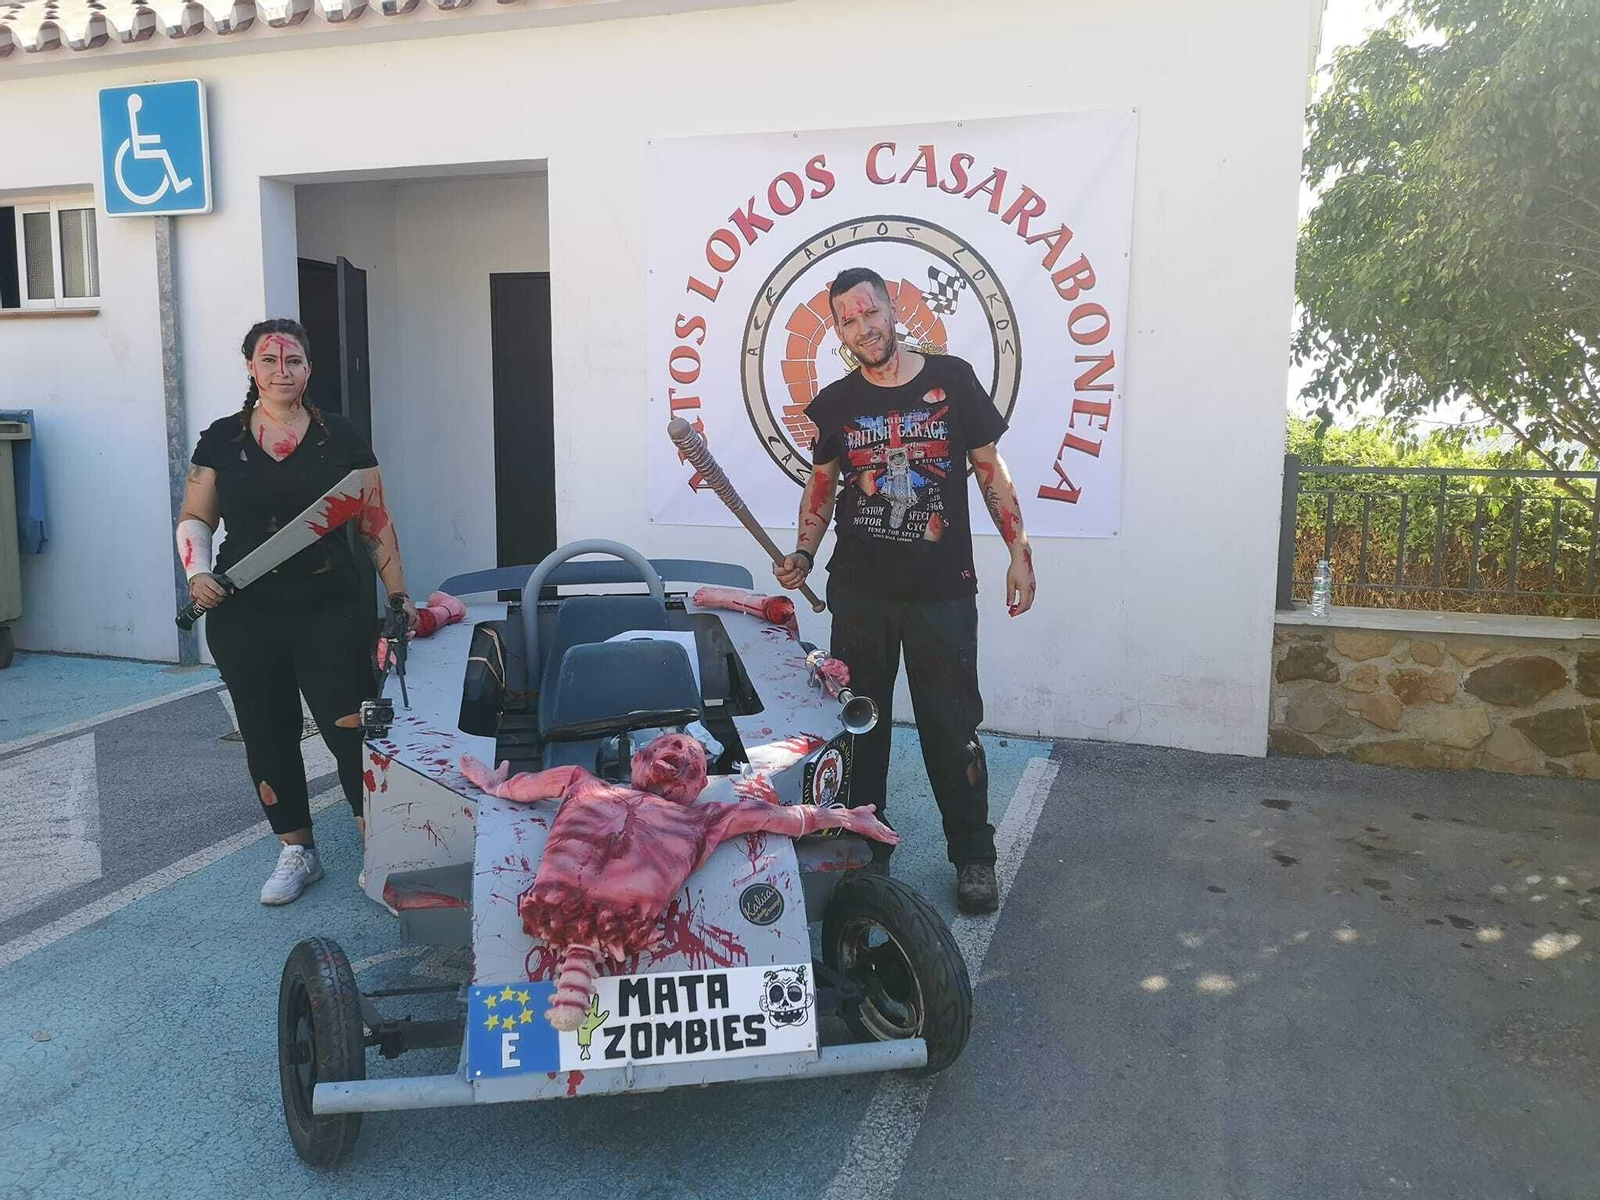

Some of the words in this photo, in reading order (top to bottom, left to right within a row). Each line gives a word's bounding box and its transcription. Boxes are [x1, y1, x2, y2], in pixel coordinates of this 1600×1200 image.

[747, 286, 778, 356] ACR
[803, 222, 921, 260] AUTOS
[953, 247, 1014, 355] LOKOS
[687, 154, 836, 303] LOKOS
[865, 142, 1115, 504] CASARABONELA
[848, 425, 892, 448] BRITISH
[897, 421, 946, 440] GARAGE
[853, 517, 882, 526] MOTOR
[618, 974, 730, 1017] MATA
[502, 1033, 521, 1069] E
[603, 1014, 767, 1060] ZOMBIES
